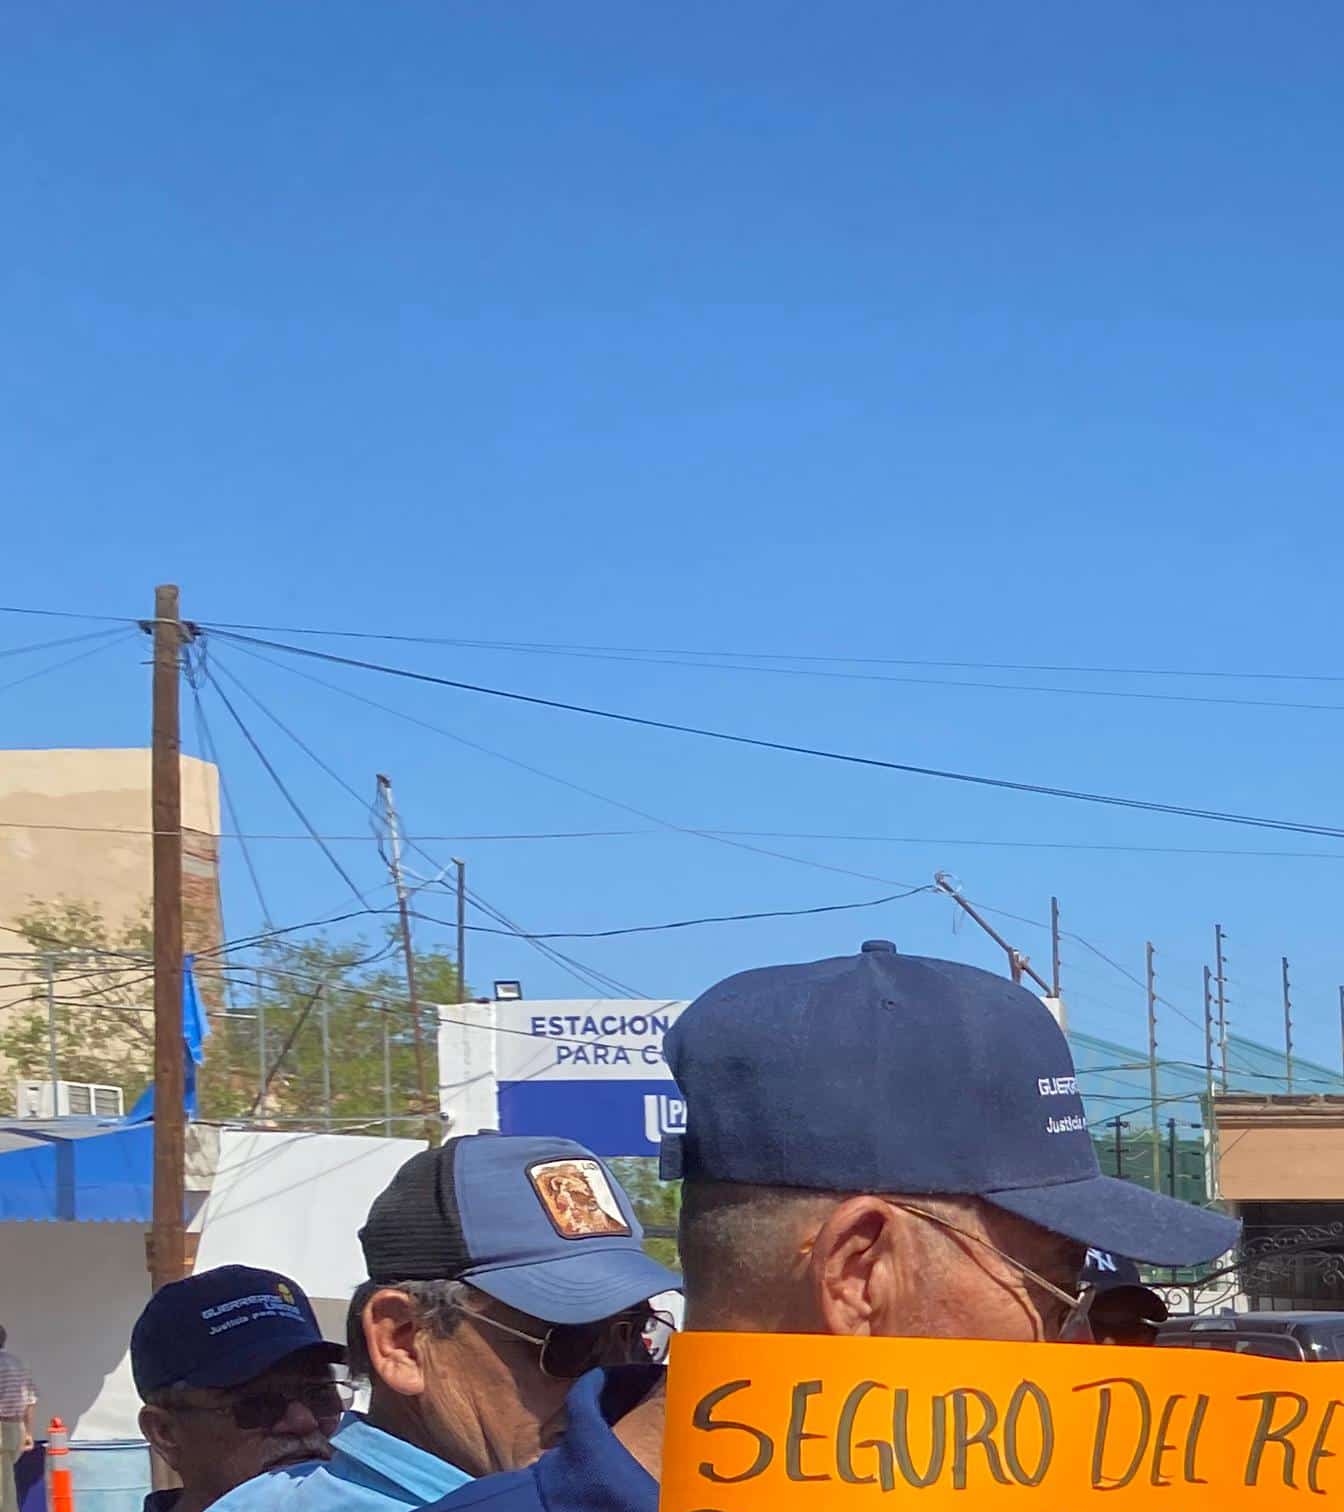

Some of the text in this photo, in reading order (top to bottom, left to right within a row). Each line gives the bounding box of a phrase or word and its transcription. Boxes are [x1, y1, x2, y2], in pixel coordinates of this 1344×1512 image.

[556, 1045, 632, 1066] PARA
[691, 1378, 1054, 1492] SEGURO
[1070, 1376, 1211, 1491] DEL
